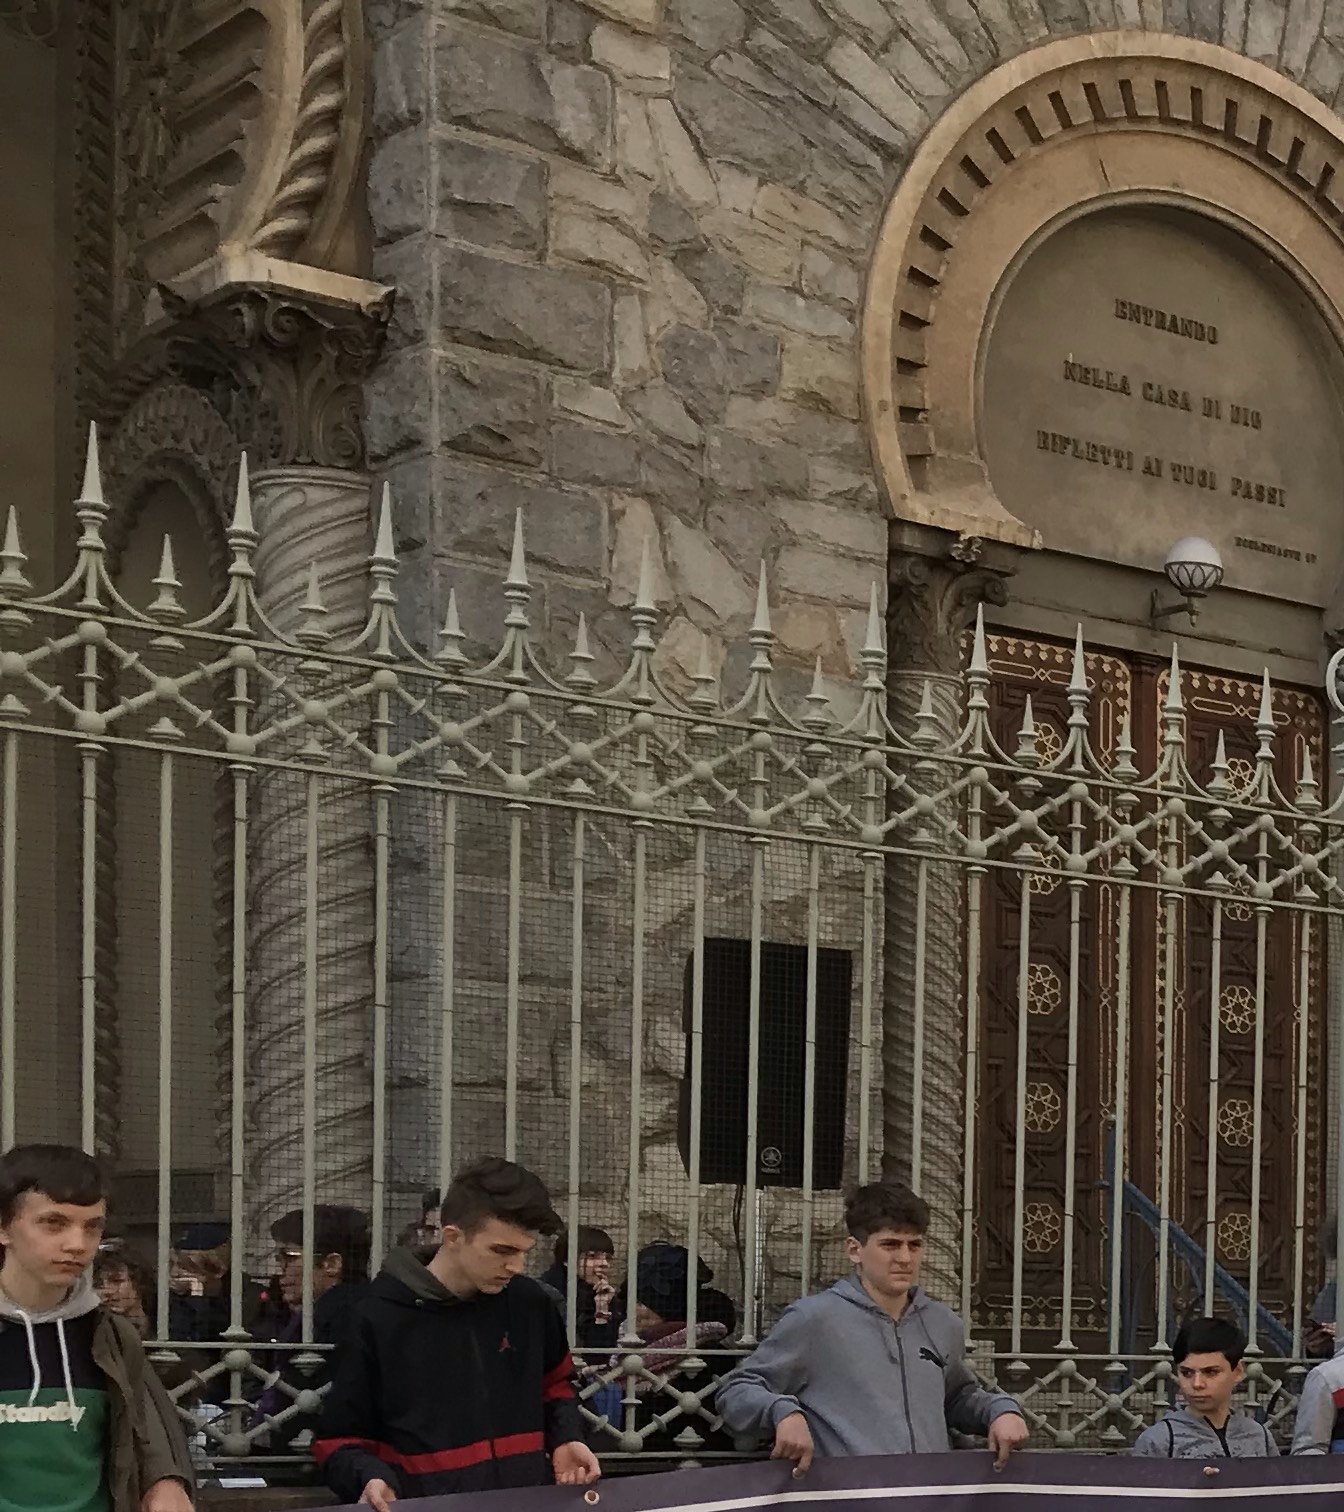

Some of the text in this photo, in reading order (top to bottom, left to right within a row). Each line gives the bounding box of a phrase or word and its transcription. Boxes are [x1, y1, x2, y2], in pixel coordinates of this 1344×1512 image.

[1114, 299, 1219, 345] ENTRANDO
[1063, 360, 1262, 430] NELLA CASA DI DIO
[1037, 430, 1287, 507] RIFLETTI AI TUOI PASSI
